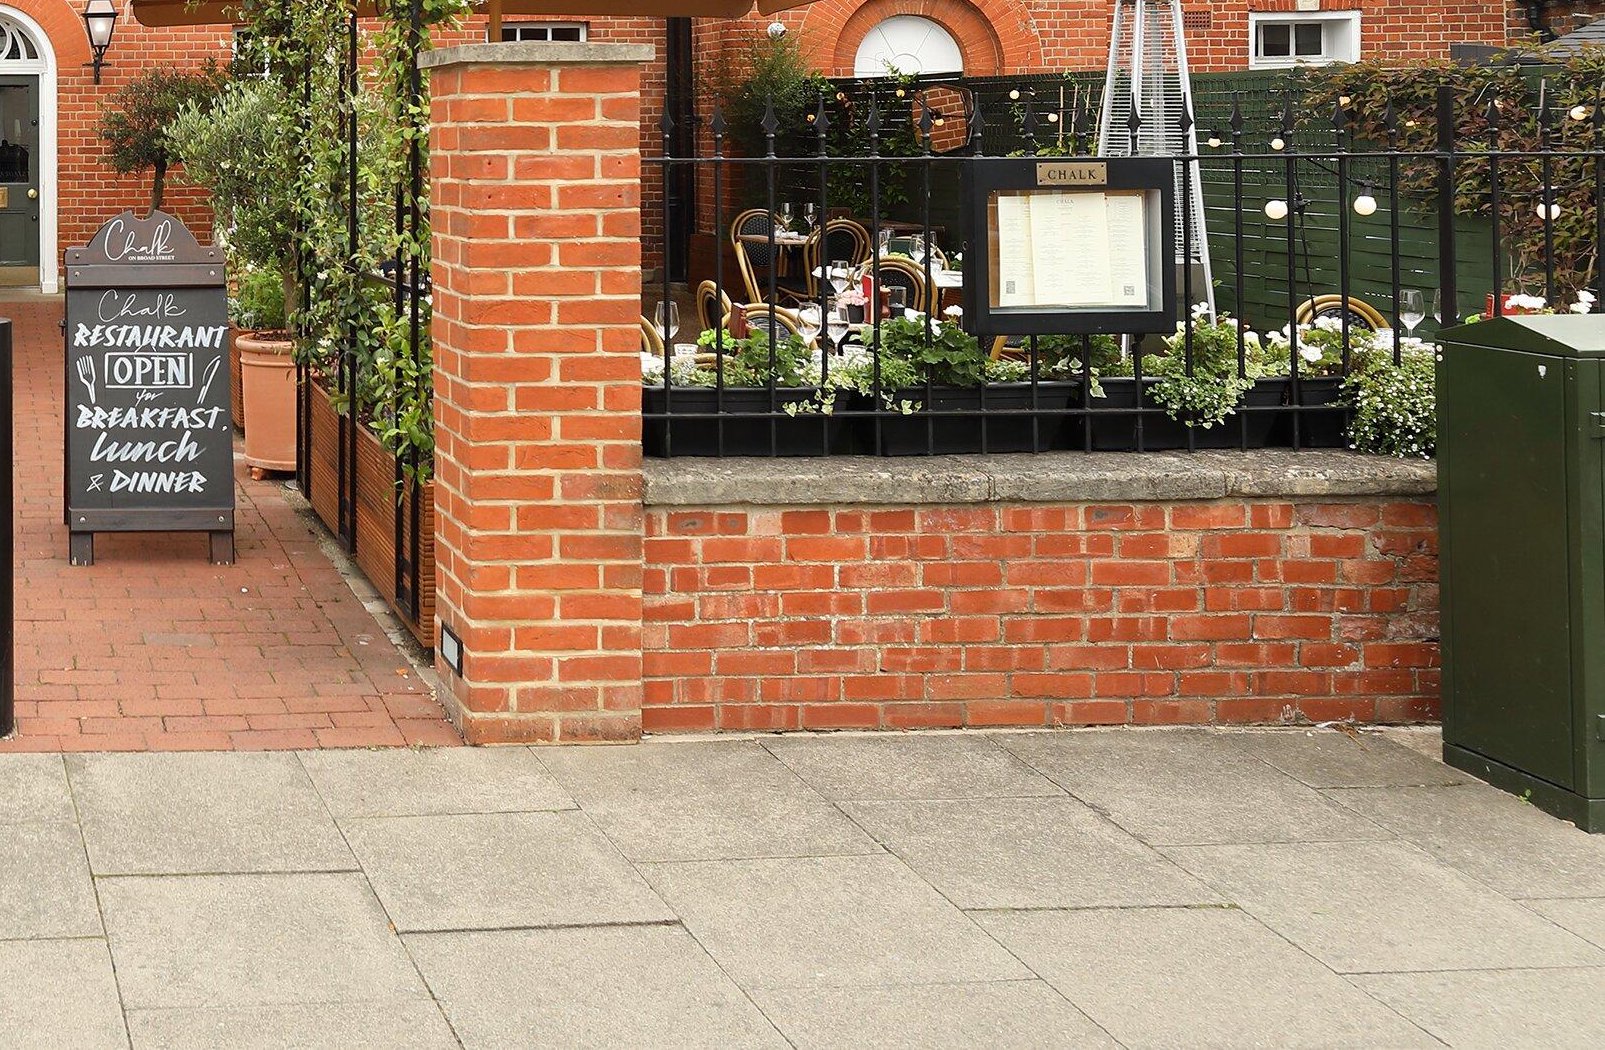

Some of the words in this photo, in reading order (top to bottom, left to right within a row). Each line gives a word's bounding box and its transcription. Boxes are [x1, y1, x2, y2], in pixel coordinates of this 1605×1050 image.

[1047, 169, 1097, 180] CHALK
[104, 219, 175, 261] Chalk
[98, 289, 187, 323] Chalk
[74, 322, 229, 349] RESTAURANT
[113, 356, 187, 386] OPEN
[109, 470, 208, 494] DINNER
